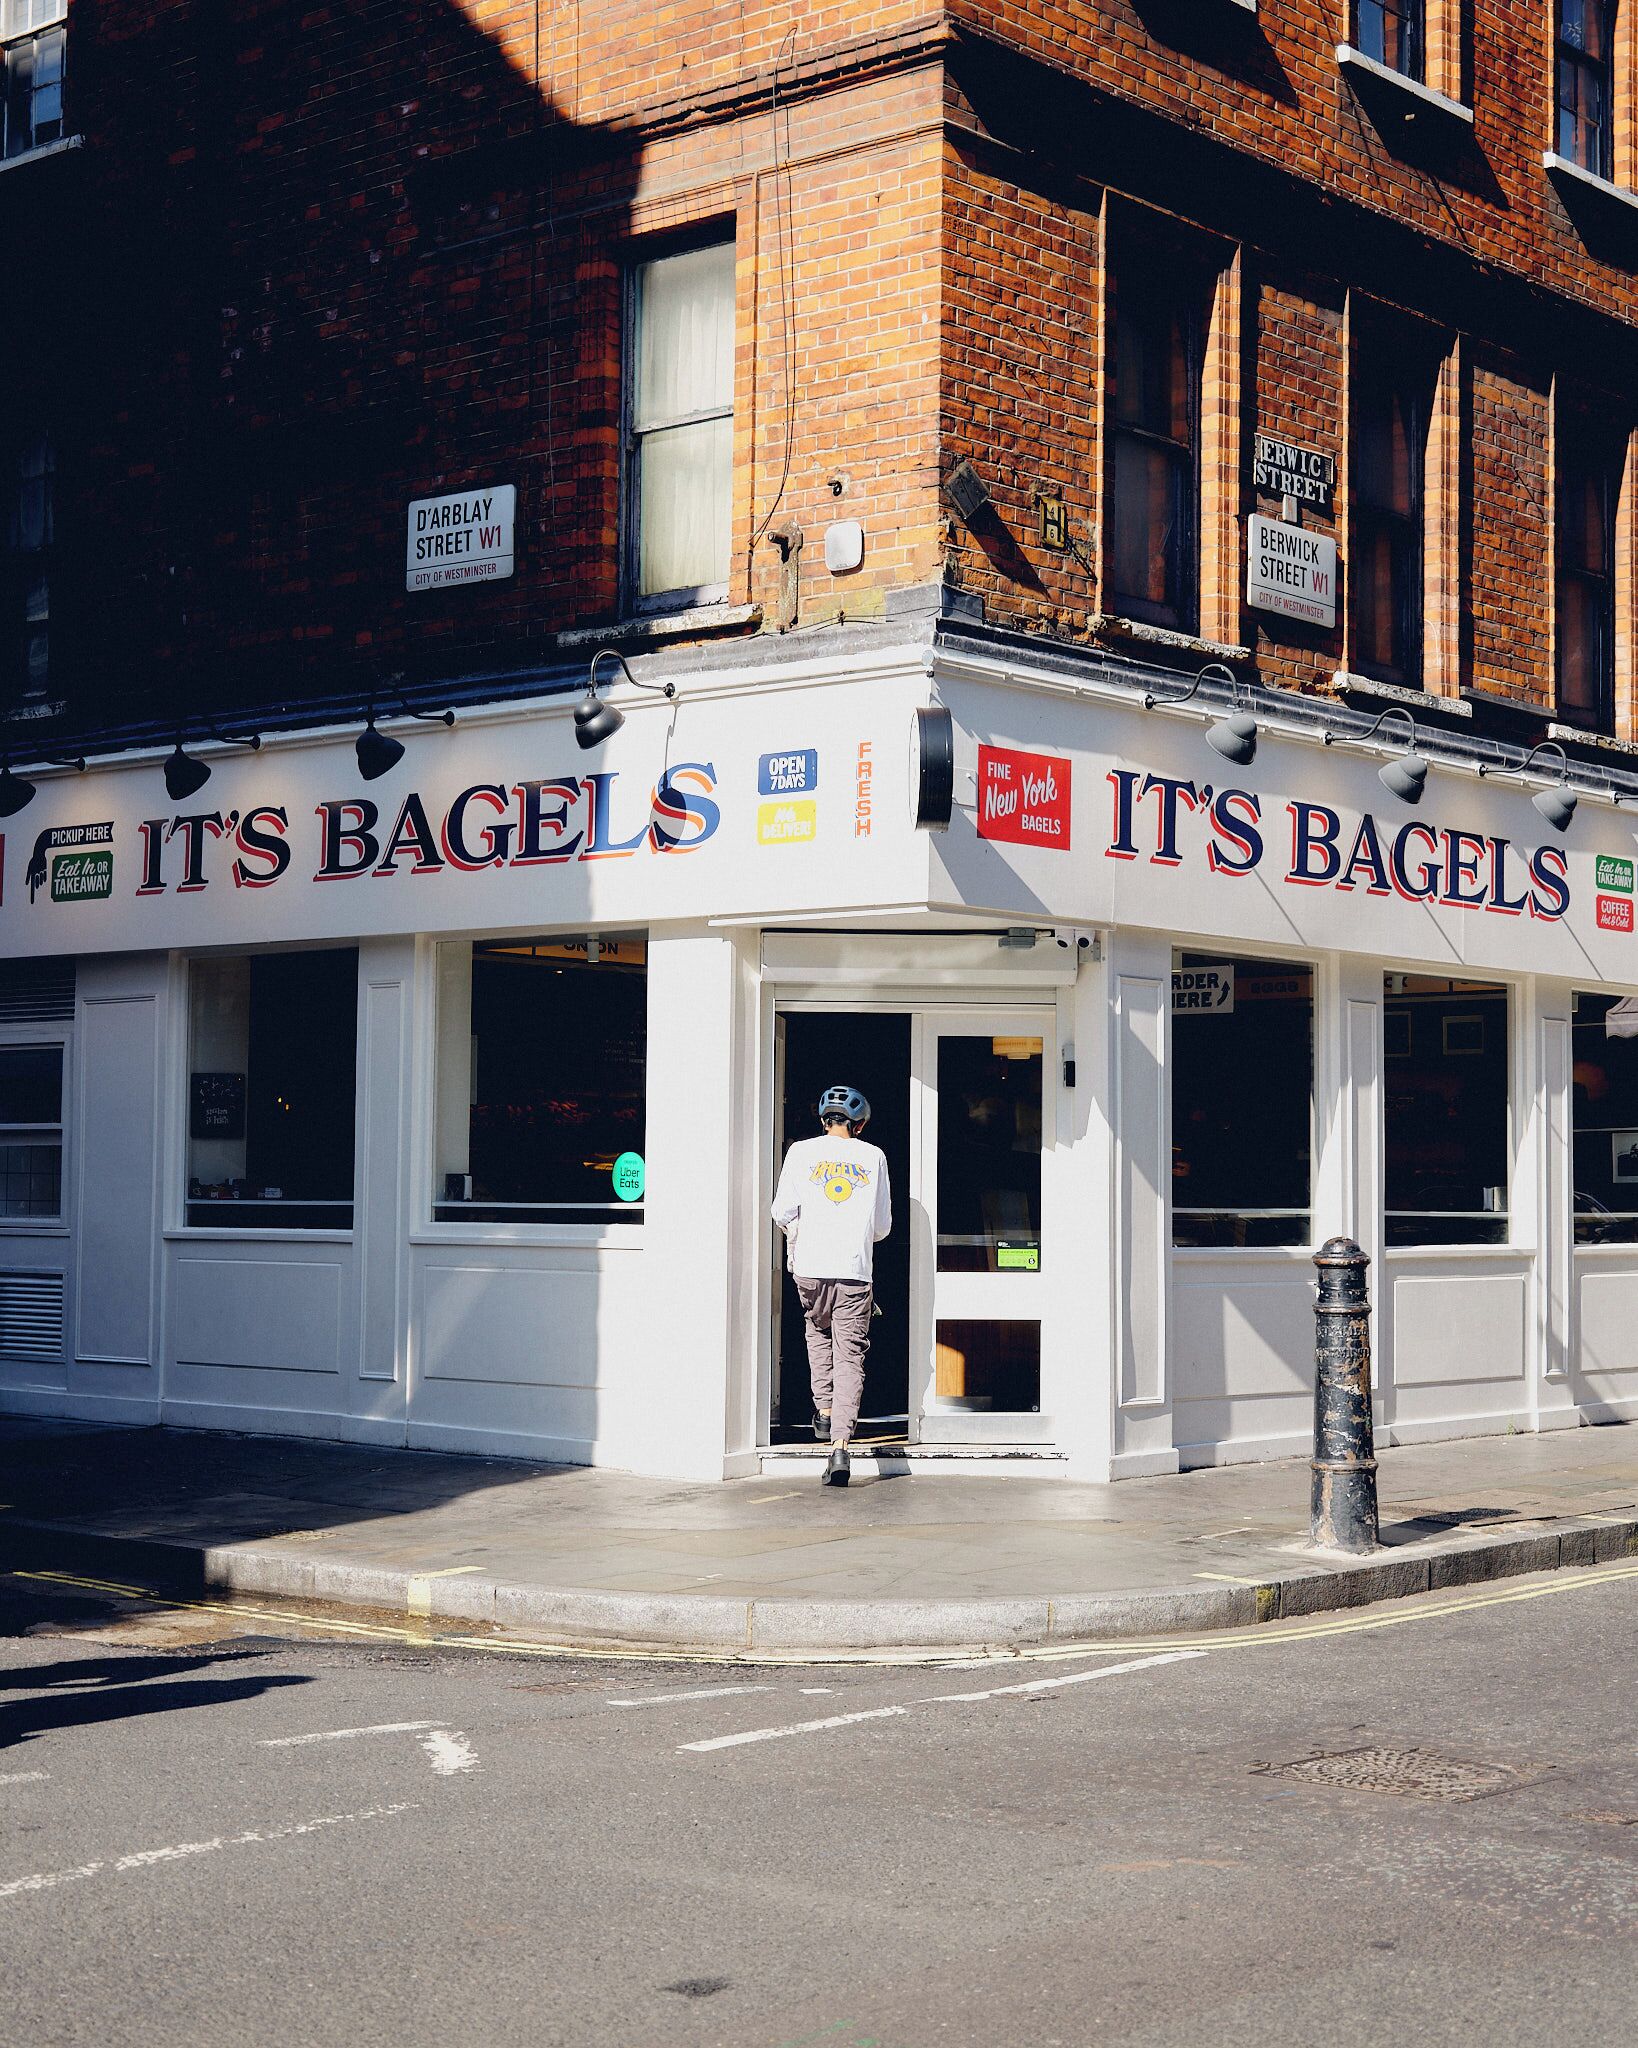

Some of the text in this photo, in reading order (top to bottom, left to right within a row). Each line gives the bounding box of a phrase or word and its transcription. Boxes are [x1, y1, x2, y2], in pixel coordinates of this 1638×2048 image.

[1256, 462, 1328, 504] STREET
[417, 498, 493, 531] D'ARBLAY
[1043, 502, 1062, 543] H
[416, 525, 502, 560] STREET W1
[1260, 526, 1319, 565] BERWICK
[415, 562, 497, 585] CITY OF WESTMINSTER
[1260, 555, 1329, 595] STREET W1
[1258, 591, 1324, 619] CITY OF WESTMINSTER
[768, 755, 806, 776] OPEN
[987, 761, 1012, 780] FINE
[855, 742, 872, 838] FRESH
[985, 765, 1058, 821] New York
[51, 825, 110, 845] PICKUP HERE
[136, 762, 720, 896] IT'S BAGELS
[1021, 814, 1061, 835] BAGELS
[1105, 768, 1571, 923] IT'S BAGELS
[57, 858, 108, 877] Eat In OR
[1598, 860, 1615, 873] Eat
[1624, 866, 1632, 876] OR
[54, 874, 110, 895] TAKEAWAY
[1597, 871, 1633, 888] TAKEAWAY
[1601, 900, 1630, 917] COFFEE
[1172, 973, 1219, 990] RDER
[619, 1178, 640, 1188] Eats
[620, 1167, 640, 1178] Uber
